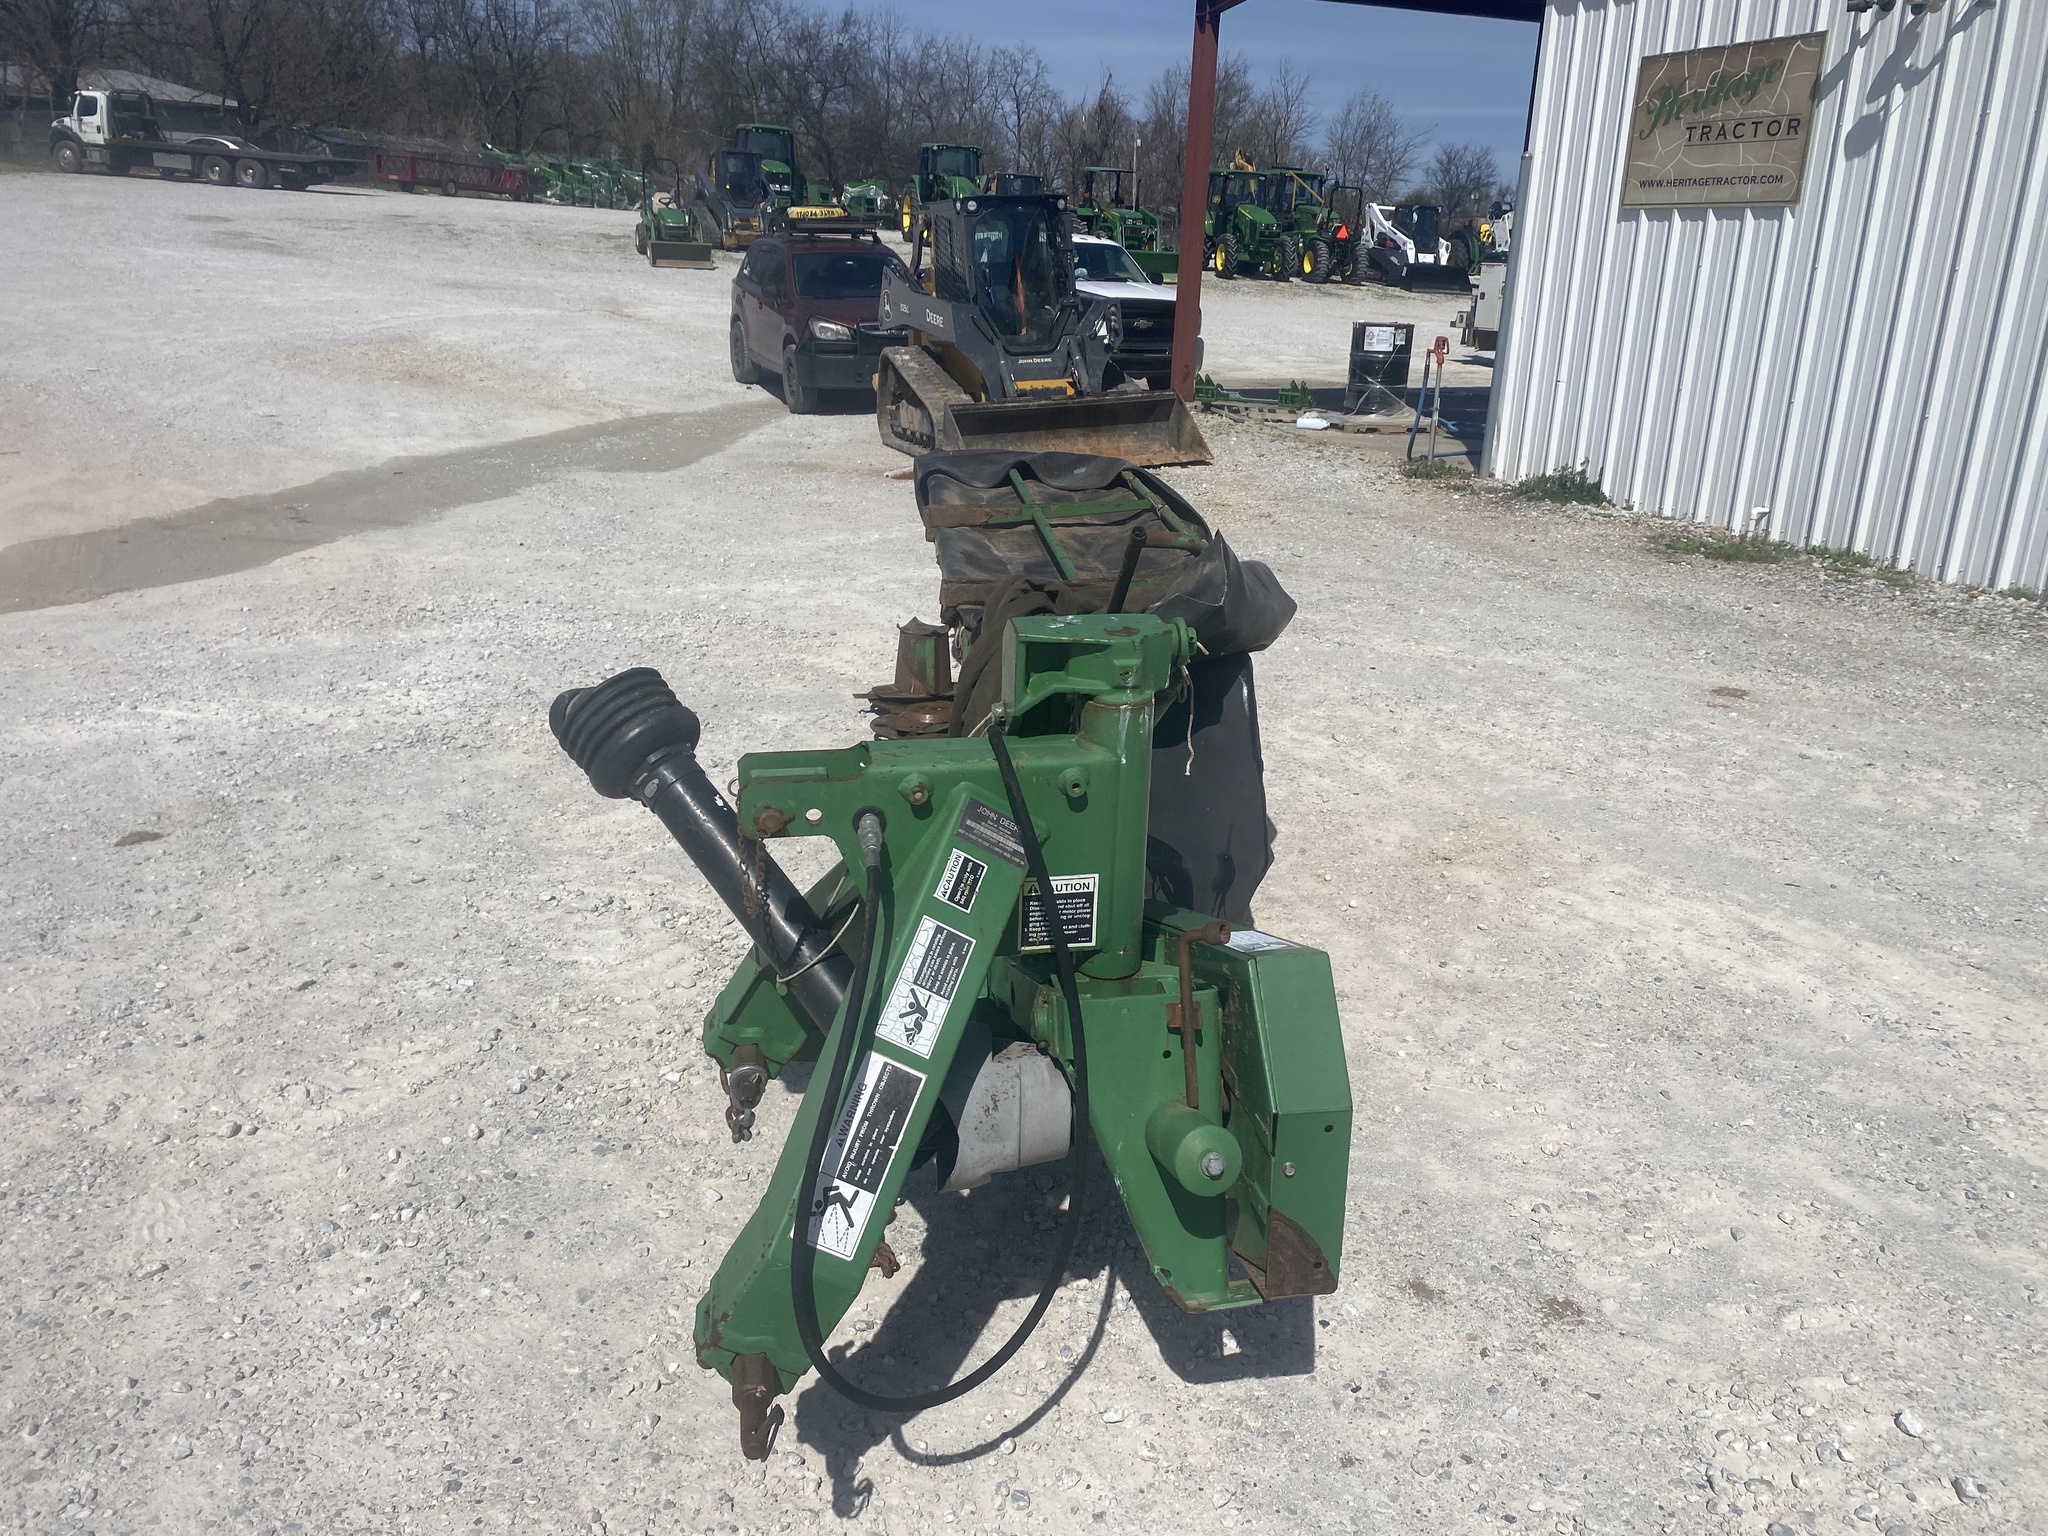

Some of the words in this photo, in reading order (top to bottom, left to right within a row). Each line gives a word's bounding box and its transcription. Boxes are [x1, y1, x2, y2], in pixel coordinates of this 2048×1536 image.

[1686, 118, 1801, 142] TRACTOR
[1639, 174, 1783, 189] WWW.HERITAGETRACTOR.COM
[926, 308, 944, 328] DEERE
[977, 807, 998, 820] JOHN
[1000, 817, 1018, 832] DEER
[943, 855, 961, 890] CAUTION
[1056, 882, 1090, 892] UTION
[939, 930, 947, 945] serious
[946, 966, 954, 983] contact
[838, 1082, 868, 1137] WARNING
[842, 1162, 852, 1179] AVOID
[850, 1139, 861, 1159] INJURY
[859, 1121, 869, 1137] FROM
[867, 1093, 880, 1117] THROWN
[879, 1065, 892, 1090] OBJECTS
